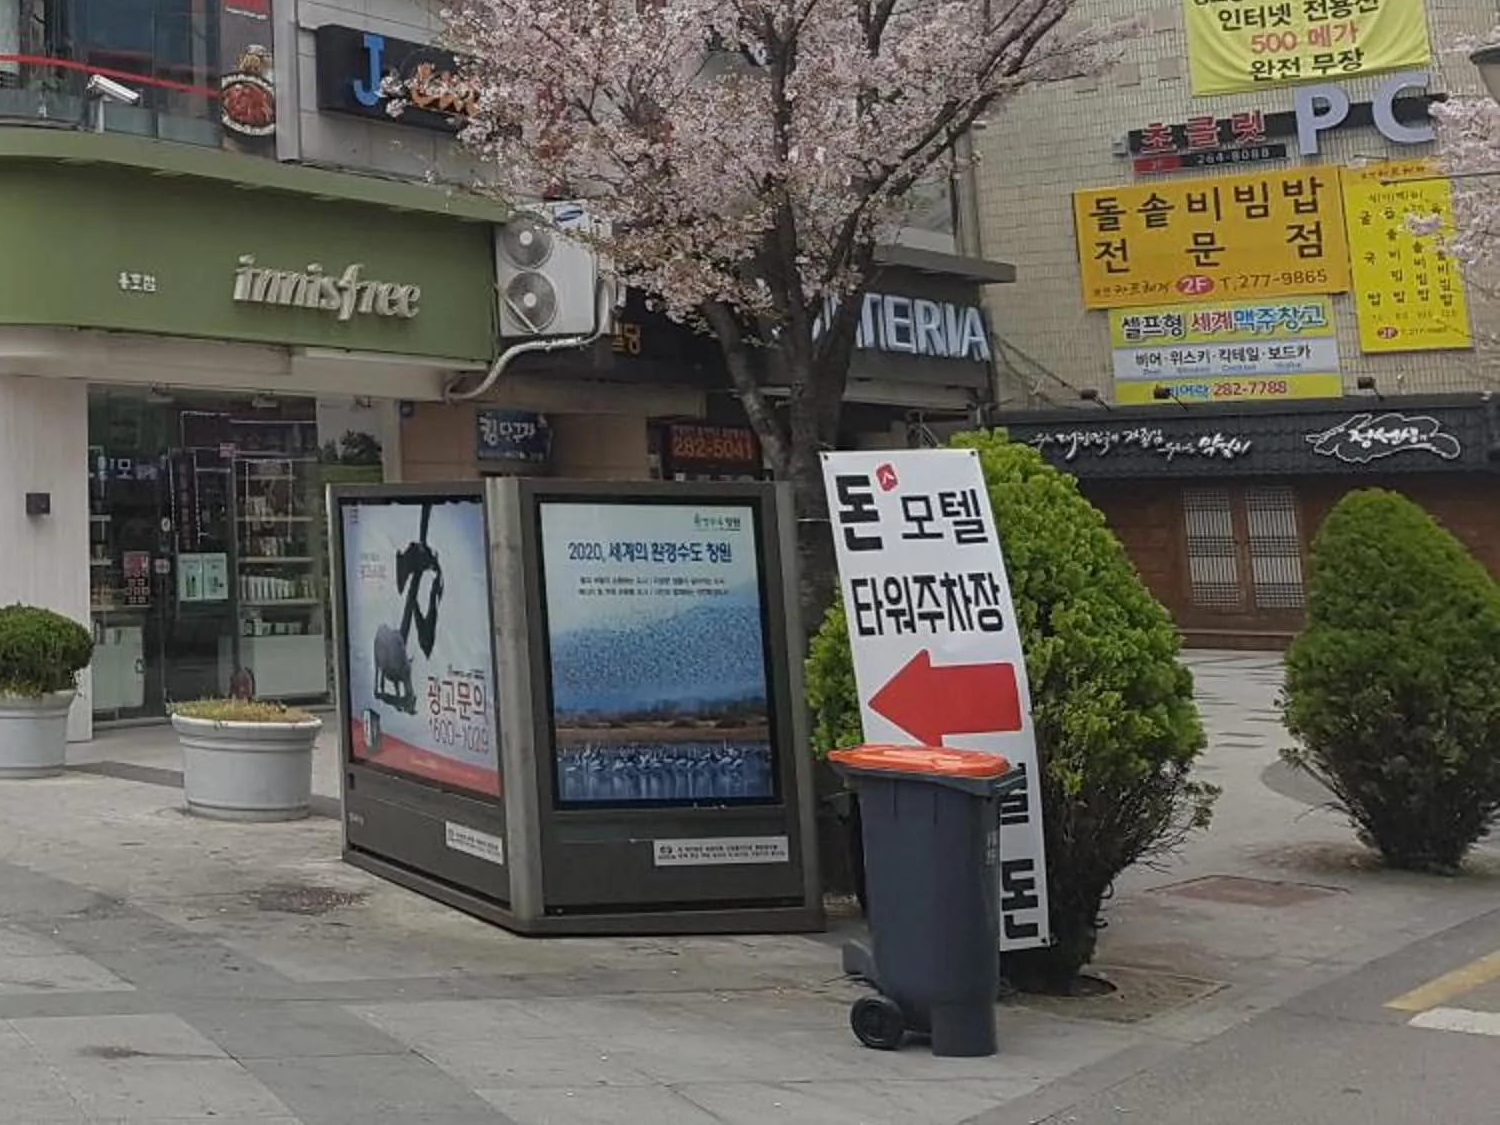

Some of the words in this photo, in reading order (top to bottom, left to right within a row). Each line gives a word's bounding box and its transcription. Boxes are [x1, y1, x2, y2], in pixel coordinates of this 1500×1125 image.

[1218, 1, 1292, 33] 인터넷
[1250, 30, 1297, 54] 500
[1307, 21, 1360, 49] 메가
[352, 32, 386, 107] J
[1248, 57, 1302, 83] 완전
[1310, 47, 1365, 74] 무장
[1293, 70, 1438, 157] PC
[1088, 175, 1325, 233] 돌솥비빔밥
[1094, 221, 1325, 275] 전문점
[232, 252, 422, 320] innisfree
[1183, 276, 1208, 293] 2F
[1219, 268, 1329, 292] T.277-9865
[1120, 314, 1186, 342] 셀프형
[1190, 304, 1326, 332] 세계맥주창고
[1134, 352, 1164, 368] 비어
[1169, 349, 1212, 367] 위스키
[1218, 346, 1260, 364] 칵테일
[1267, 346, 1312, 362] 보드카
[1212, 381, 1288, 398] 282-7788
[834, 474, 884, 552] 돈
[900, 488, 989, 545] 모텔
[849, 571, 1006, 639] 타워주차장
[426, 675, 489, 724] 광고문의
